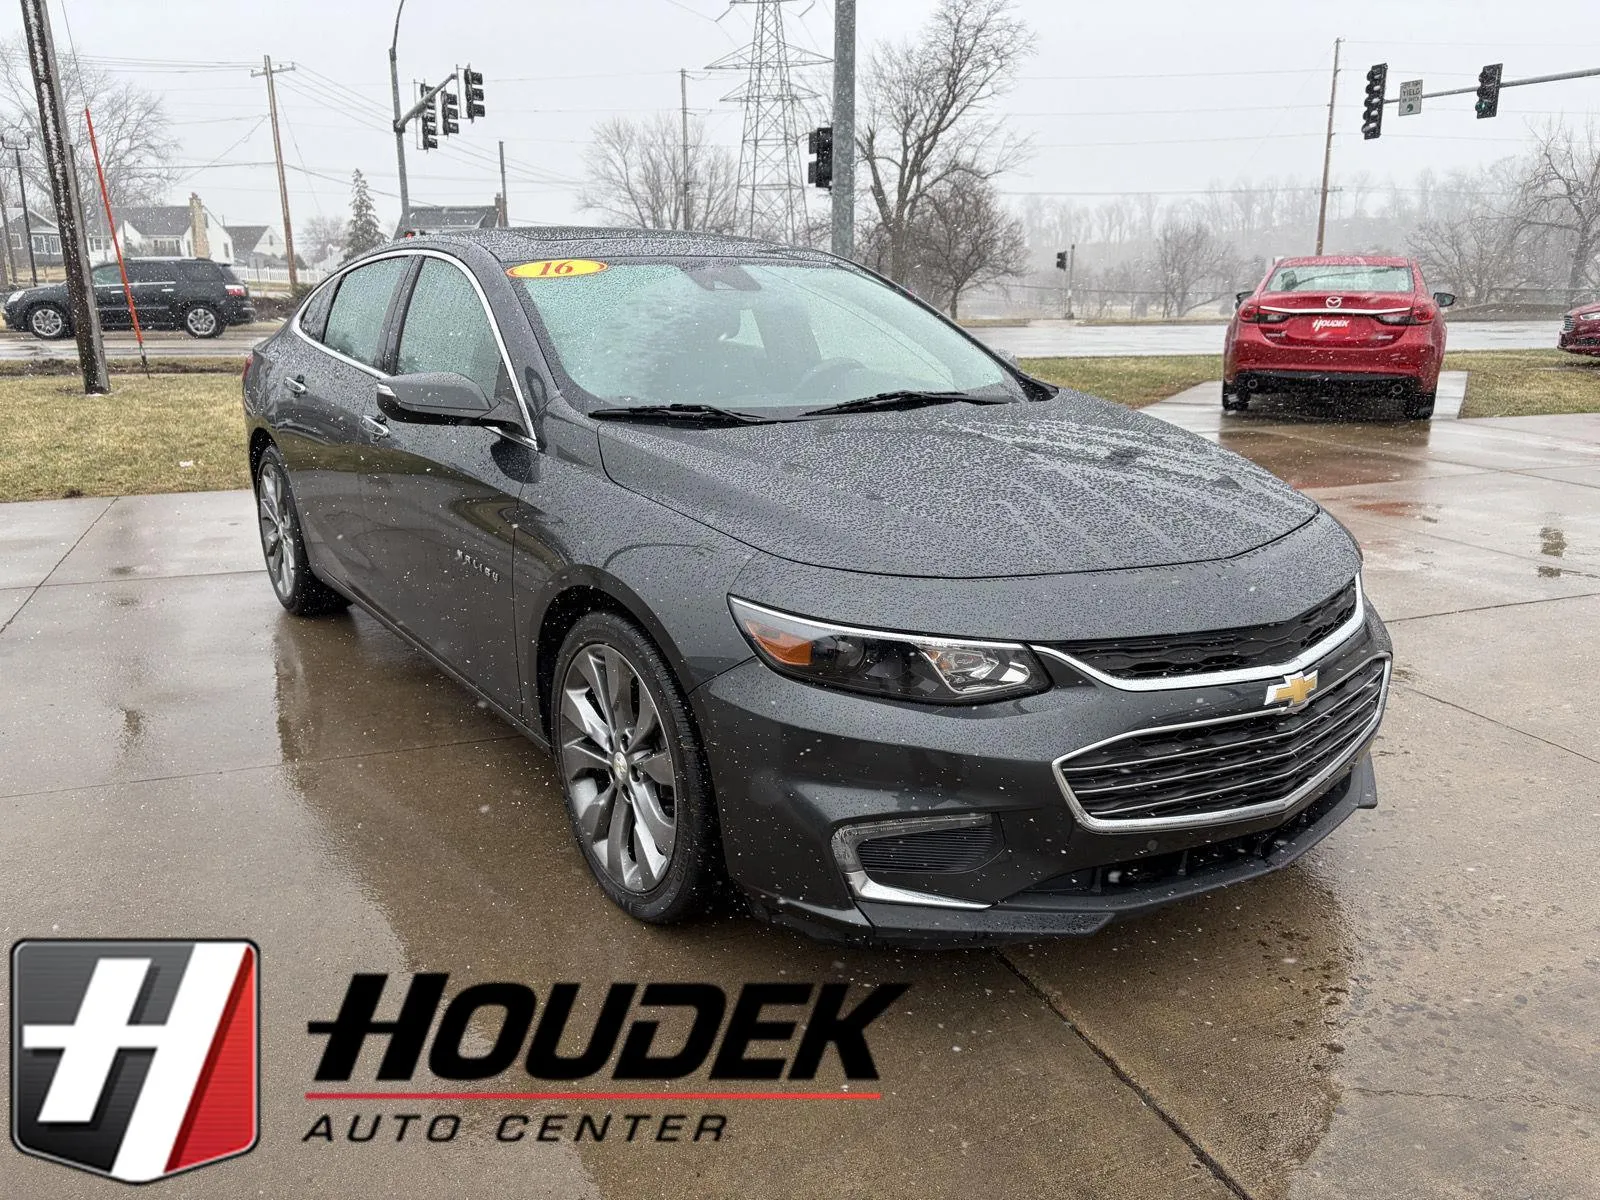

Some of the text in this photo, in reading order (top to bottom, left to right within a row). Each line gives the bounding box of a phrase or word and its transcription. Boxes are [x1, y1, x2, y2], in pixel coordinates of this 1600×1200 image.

[1402, 88, 1421, 96] YIELD
[538, 261, 574, 276] 16
[454, 549, 499, 582] MALIBU
